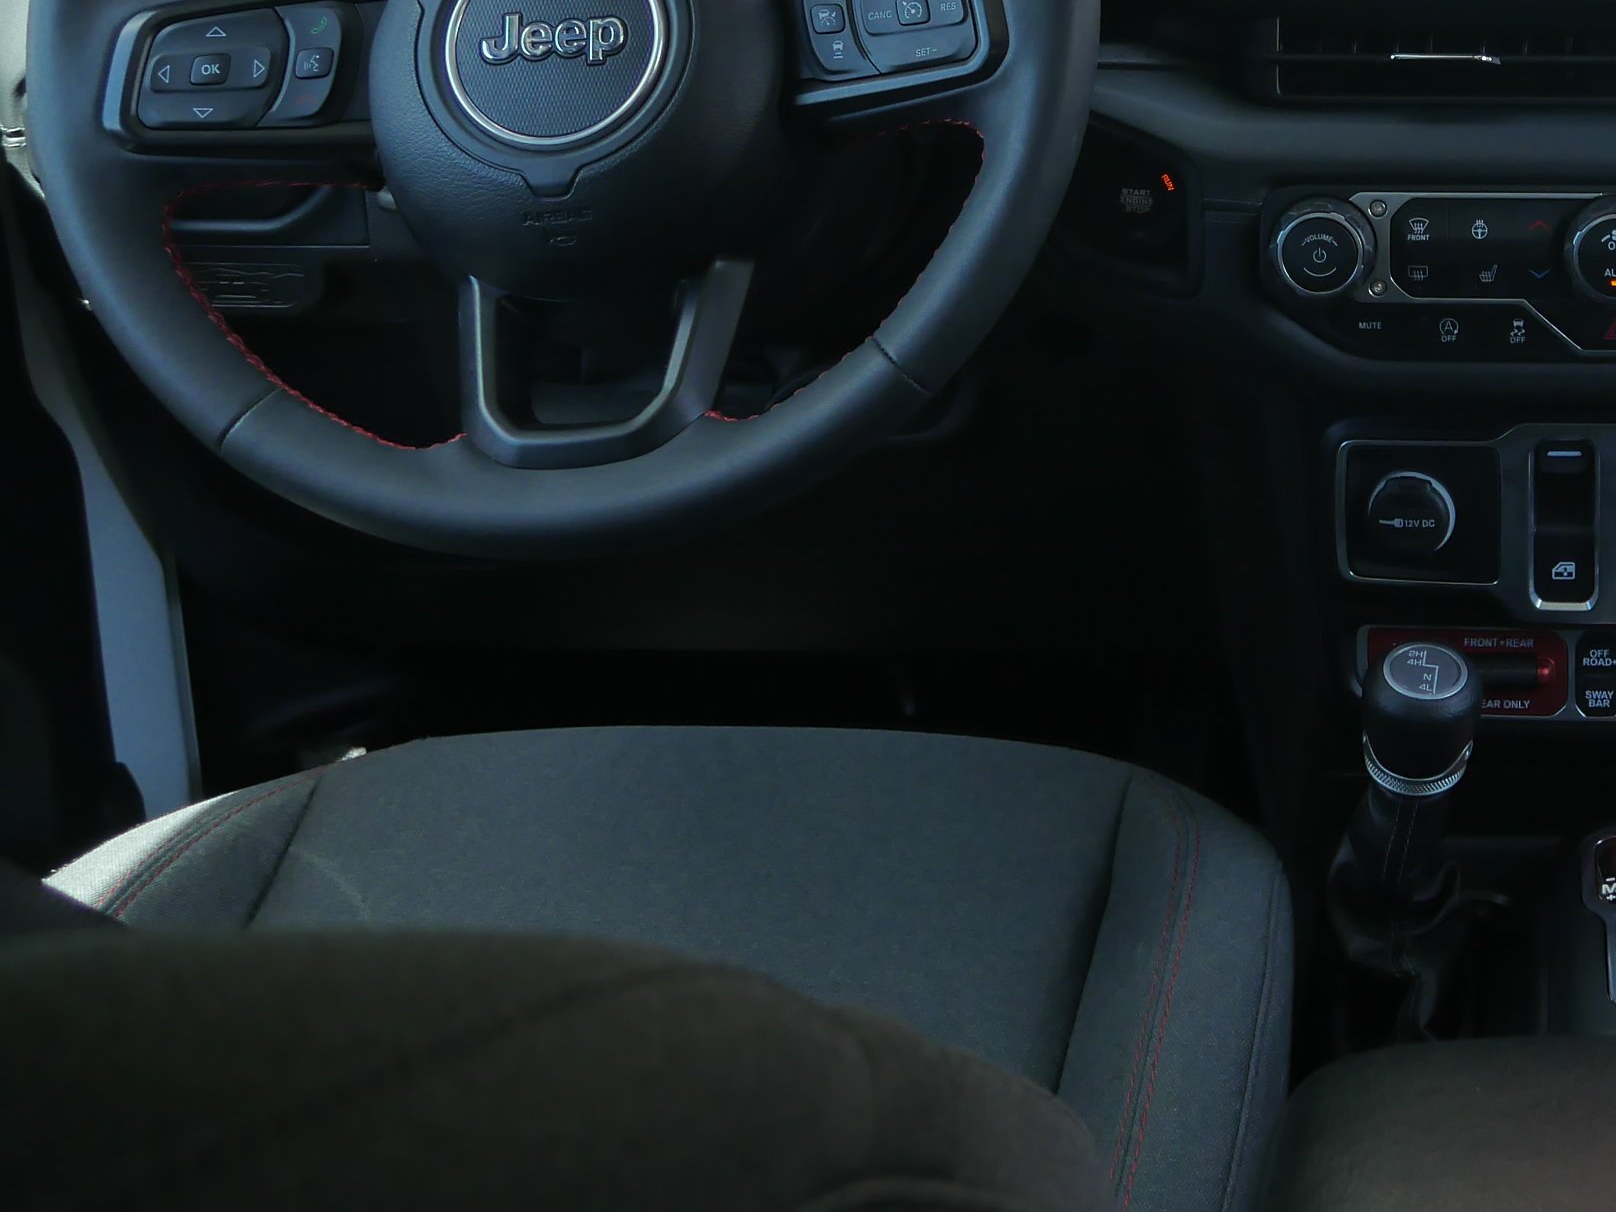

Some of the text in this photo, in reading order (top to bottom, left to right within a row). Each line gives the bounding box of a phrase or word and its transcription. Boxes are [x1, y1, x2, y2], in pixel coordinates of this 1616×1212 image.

[868, 2, 957, 21] CANC RES
[479, 11, 628, 66] Jeep
[201, 63, 220, 75] OK
[1305, 232, 1333, 243] VOLUME
[1407, 233, 1430, 241] FRONT
[1358, 321, 1382, 330] MUTE
[1441, 335, 1457, 343] OFF
[1510, 336, 1526, 344] OFF
[1405, 519, 1435, 528] 12V DC
[1408, 649, 1424, 658] 2H
[1589, 649, 1609, 658] OFF
[1406, 658, 1423, 667] 4H
[1423, 673, 1432, 681] N
[1418, 683, 1433, 692] 4L
[1585, 690, 1614, 700] SWAY
[1503, 700, 1530, 709] ONLY
[1588, 699, 1611, 708] BAR
